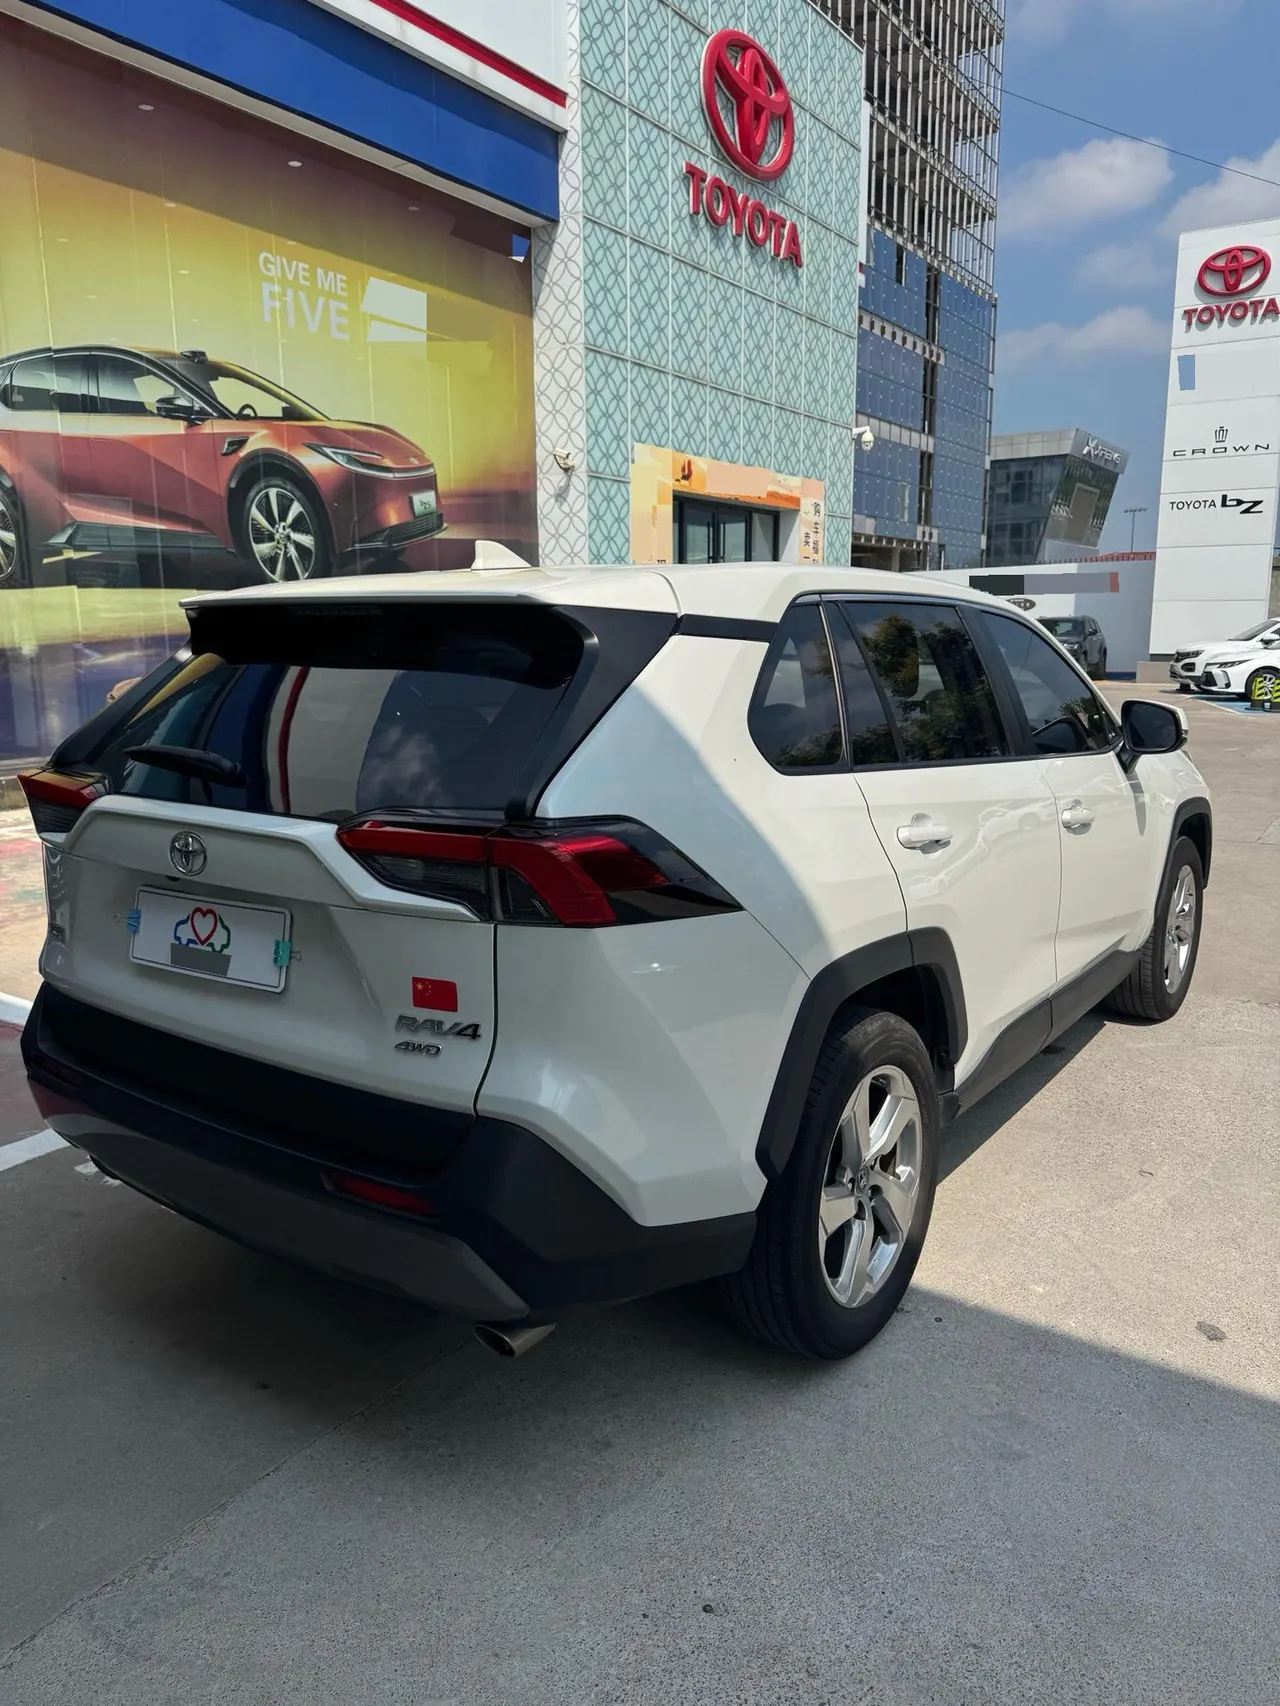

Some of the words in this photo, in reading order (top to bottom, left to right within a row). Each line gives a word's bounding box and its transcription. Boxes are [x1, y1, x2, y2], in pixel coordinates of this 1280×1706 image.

[683, 160, 804, 269] TOYOTA
[258, 251, 311, 287] GIVE
[317, 267, 348, 297] ME
[261, 281, 351, 342] FIVE
[1183, 297, 1280, 326] TOYOTA
[1172, 443, 1270, 457] CROWN
[1169, 499, 1217, 511] TOYOTA
[395, 1014, 483, 1040] RAV4
[394, 1040, 444, 1055] 4WD
